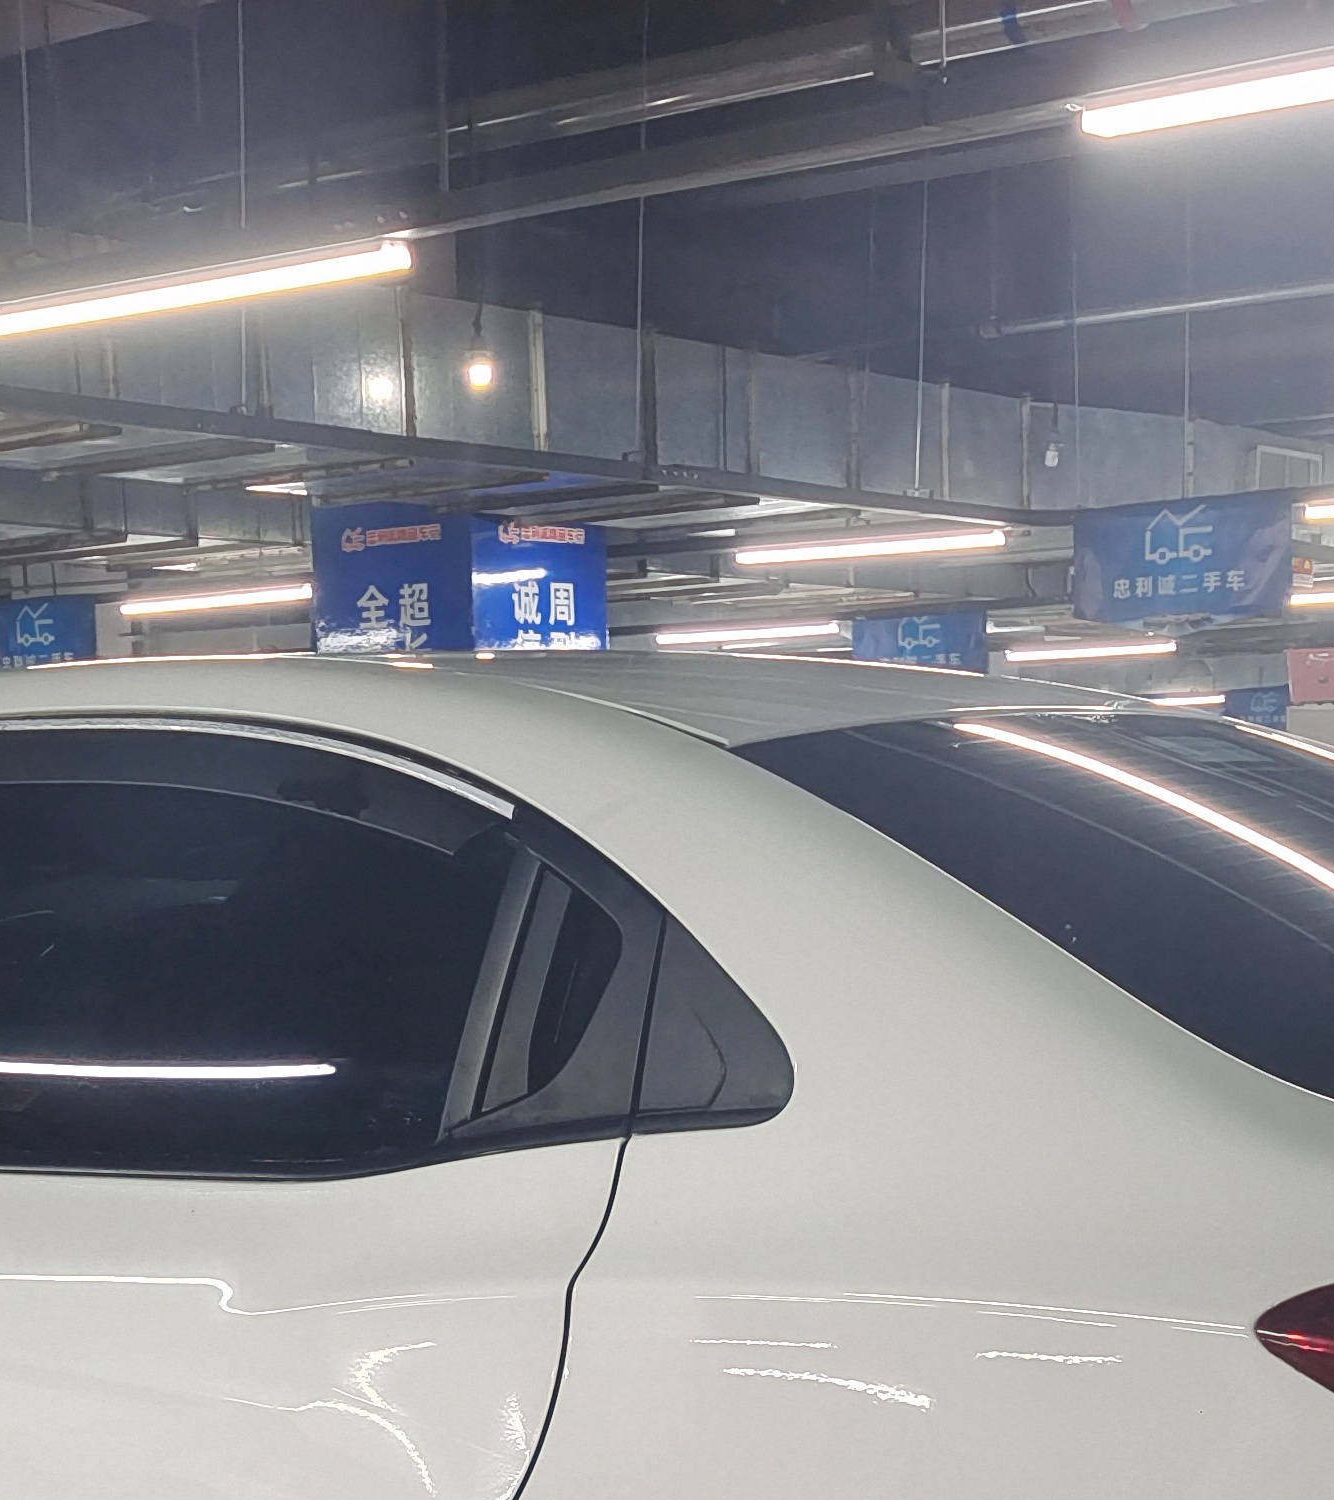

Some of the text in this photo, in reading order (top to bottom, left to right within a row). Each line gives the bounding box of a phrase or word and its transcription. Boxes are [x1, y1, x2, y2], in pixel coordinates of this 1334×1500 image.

[1113, 570, 1246, 599] 忠利诚二手车
